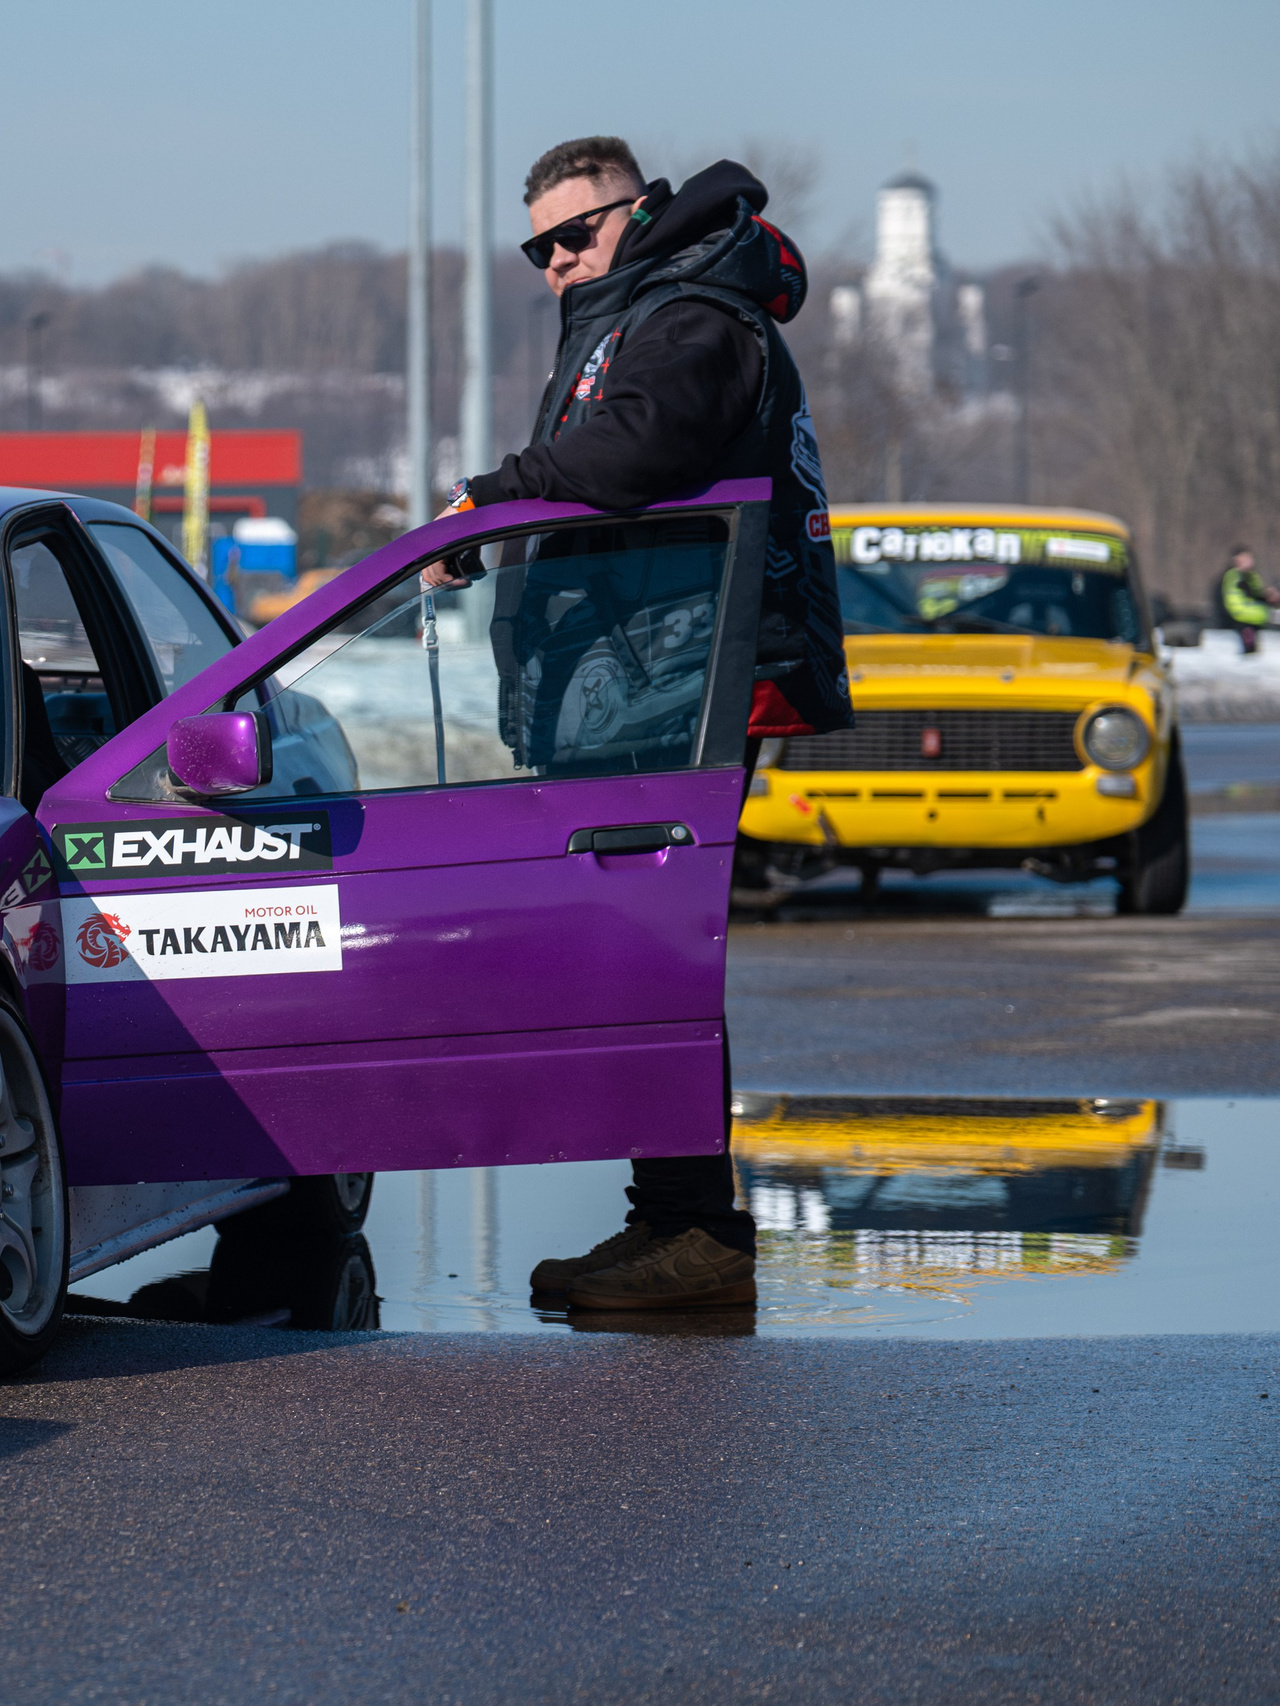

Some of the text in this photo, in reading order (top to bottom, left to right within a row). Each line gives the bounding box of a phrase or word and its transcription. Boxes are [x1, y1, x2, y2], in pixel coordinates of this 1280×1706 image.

[112, 823, 313, 867] EXHAUST
[244, 905, 318, 918] MOTOR OIL
[138, 921, 327, 956] TAKAYAMA
